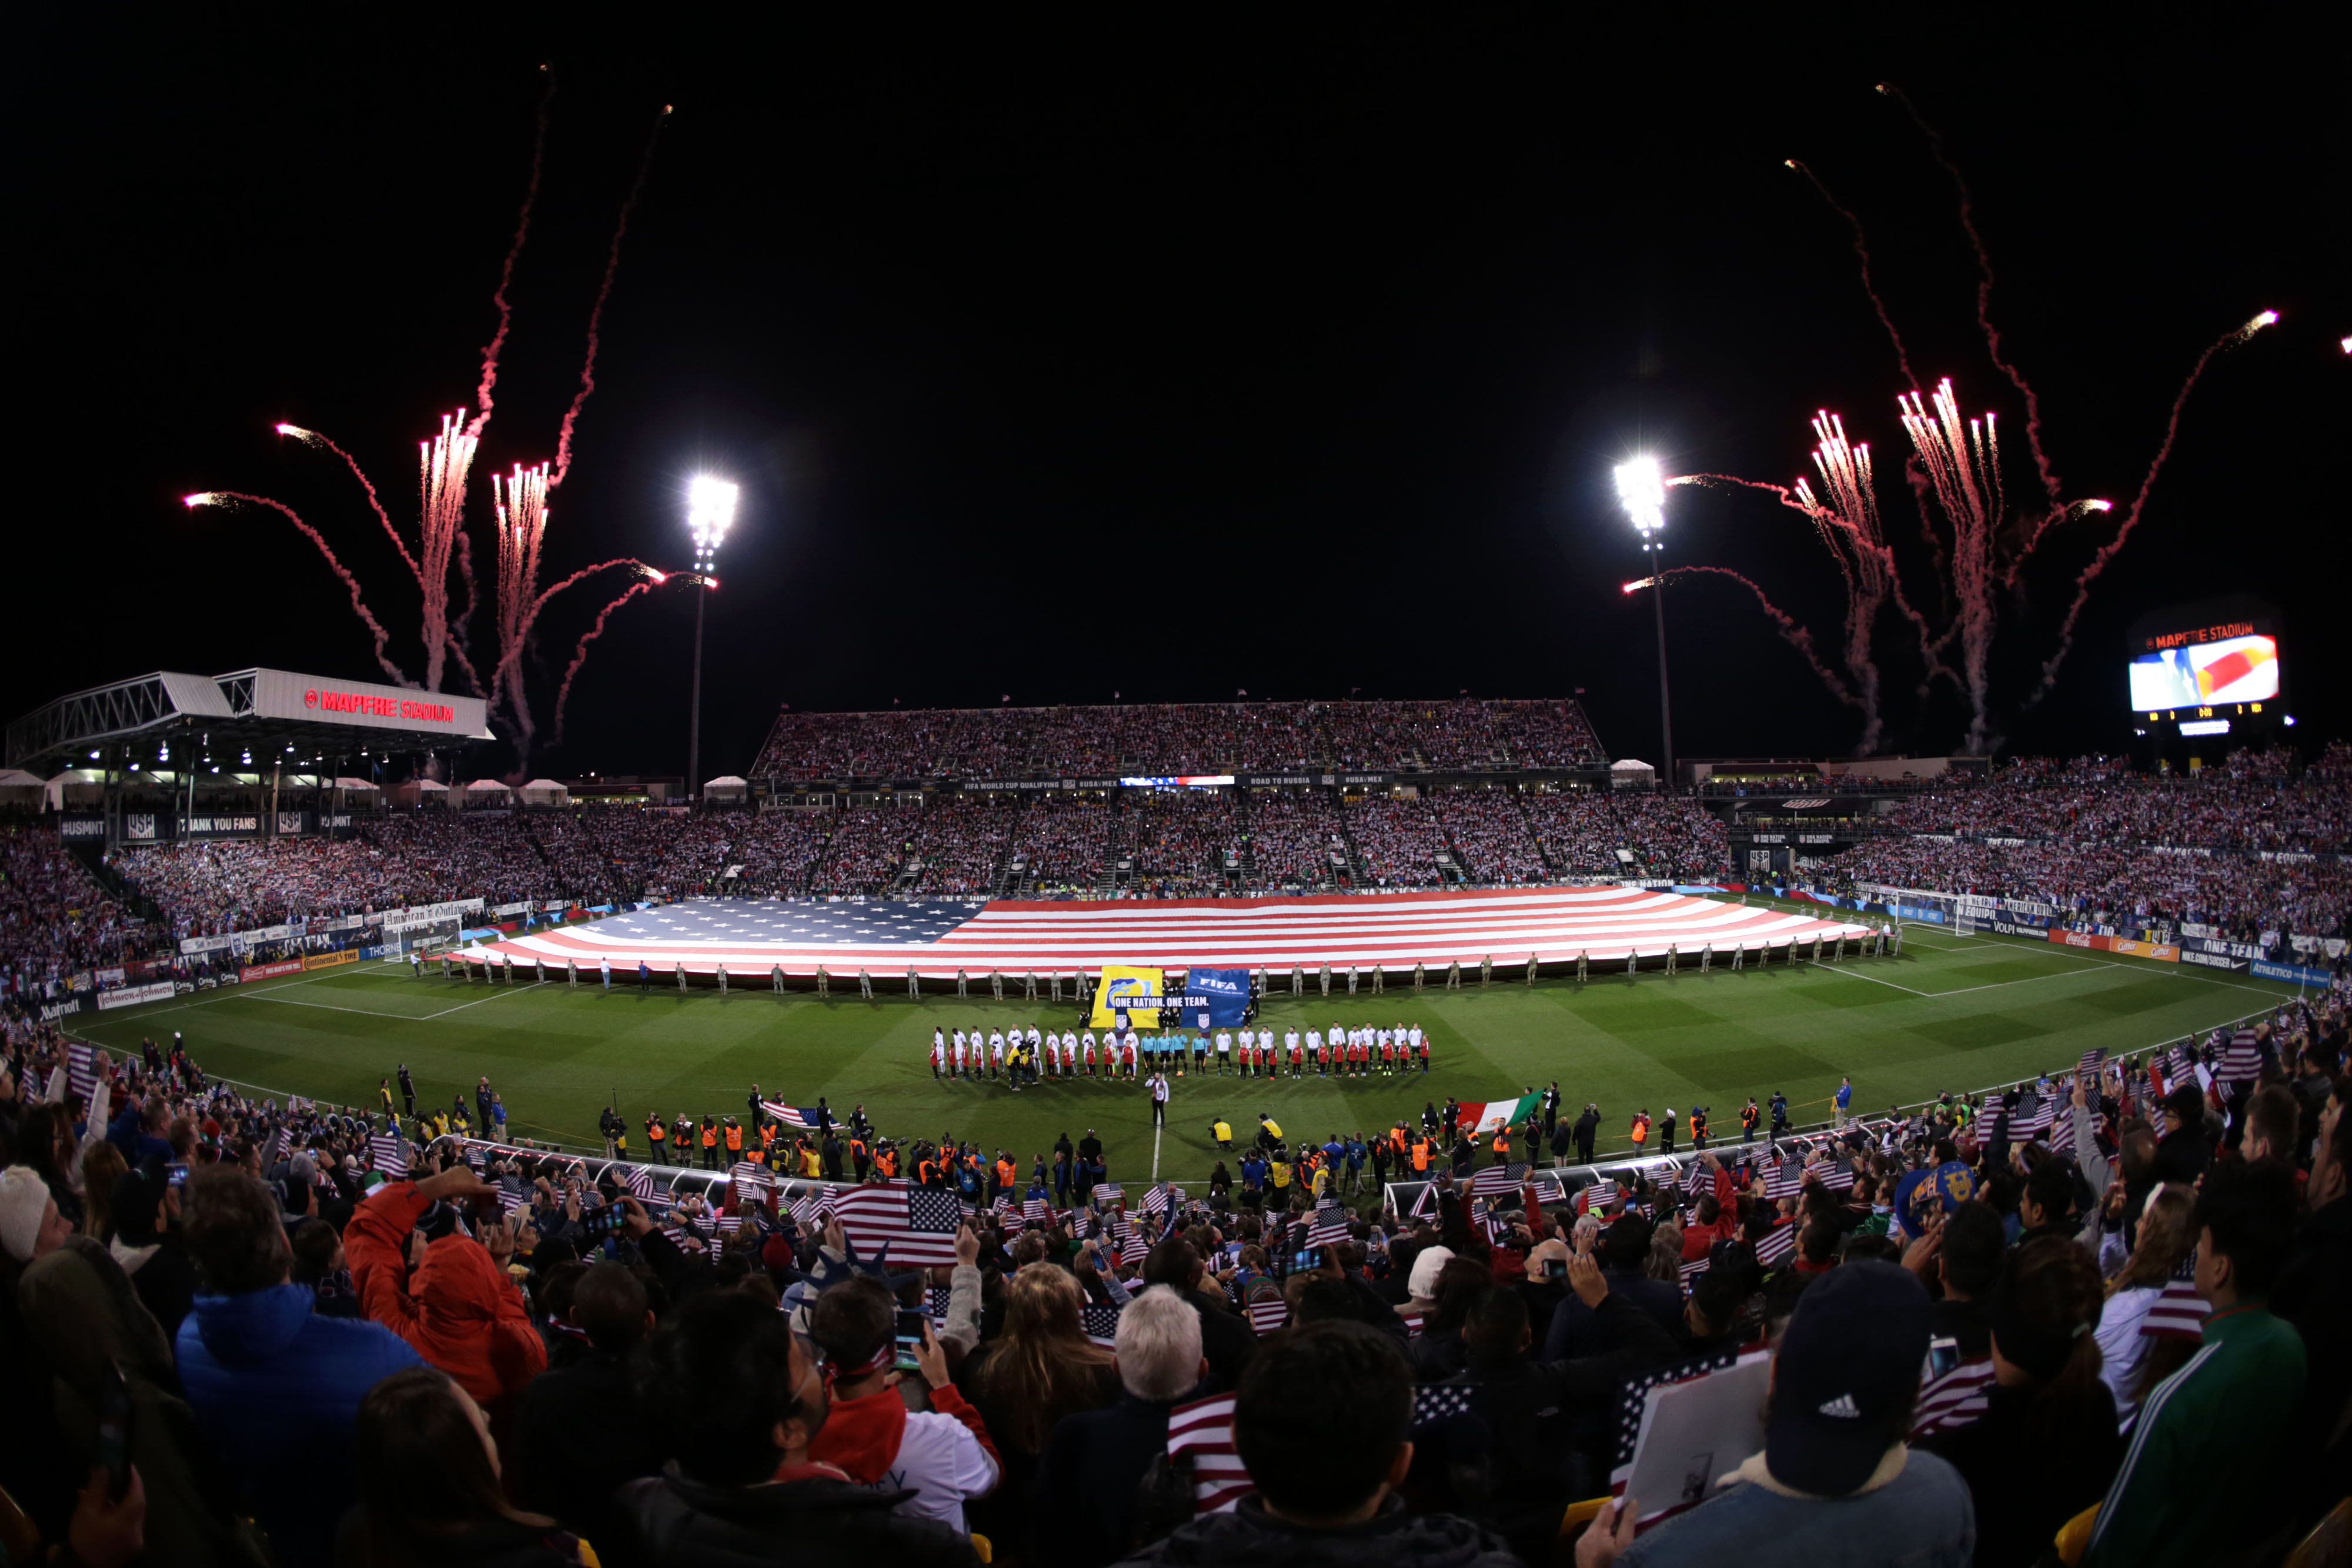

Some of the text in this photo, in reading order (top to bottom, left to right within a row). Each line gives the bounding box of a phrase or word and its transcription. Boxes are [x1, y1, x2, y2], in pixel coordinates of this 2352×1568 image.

[2156, 622, 2254, 648] MAPFRE STADIUM
[322, 690, 453, 723] MAPFRE STADIUM
[62, 820, 105, 835] #USMNT
[213, 818, 232, 831] YOU
[233, 817, 256, 830] FANS
[435, 903, 469, 918] Outlaws
[1965, 905, 1998, 921] EQUIPO.
[386, 911, 425, 927] American
[1993, 920, 2015, 935] VOLPI
[2118, 942, 2137, 951] Cutter
[2150, 948, 2170, 957] Cutter
[2204, 940, 2267, 961] ONE TEAM.
[304, 951, 358, 970] Continental TIRE
[2181, 951, 2230, 968] NIKE.COM/SOCCER
[220, 973, 234, 981] Century
[2253, 962, 2293, 979] ATHLETICO
[198, 977, 212, 986] Century
[1200, 978, 1237, 991] FIFA
[39, 998, 79, 1022] Marriott
[1115, 997, 1210, 1008] ONE NATION. ONE TEAM.
